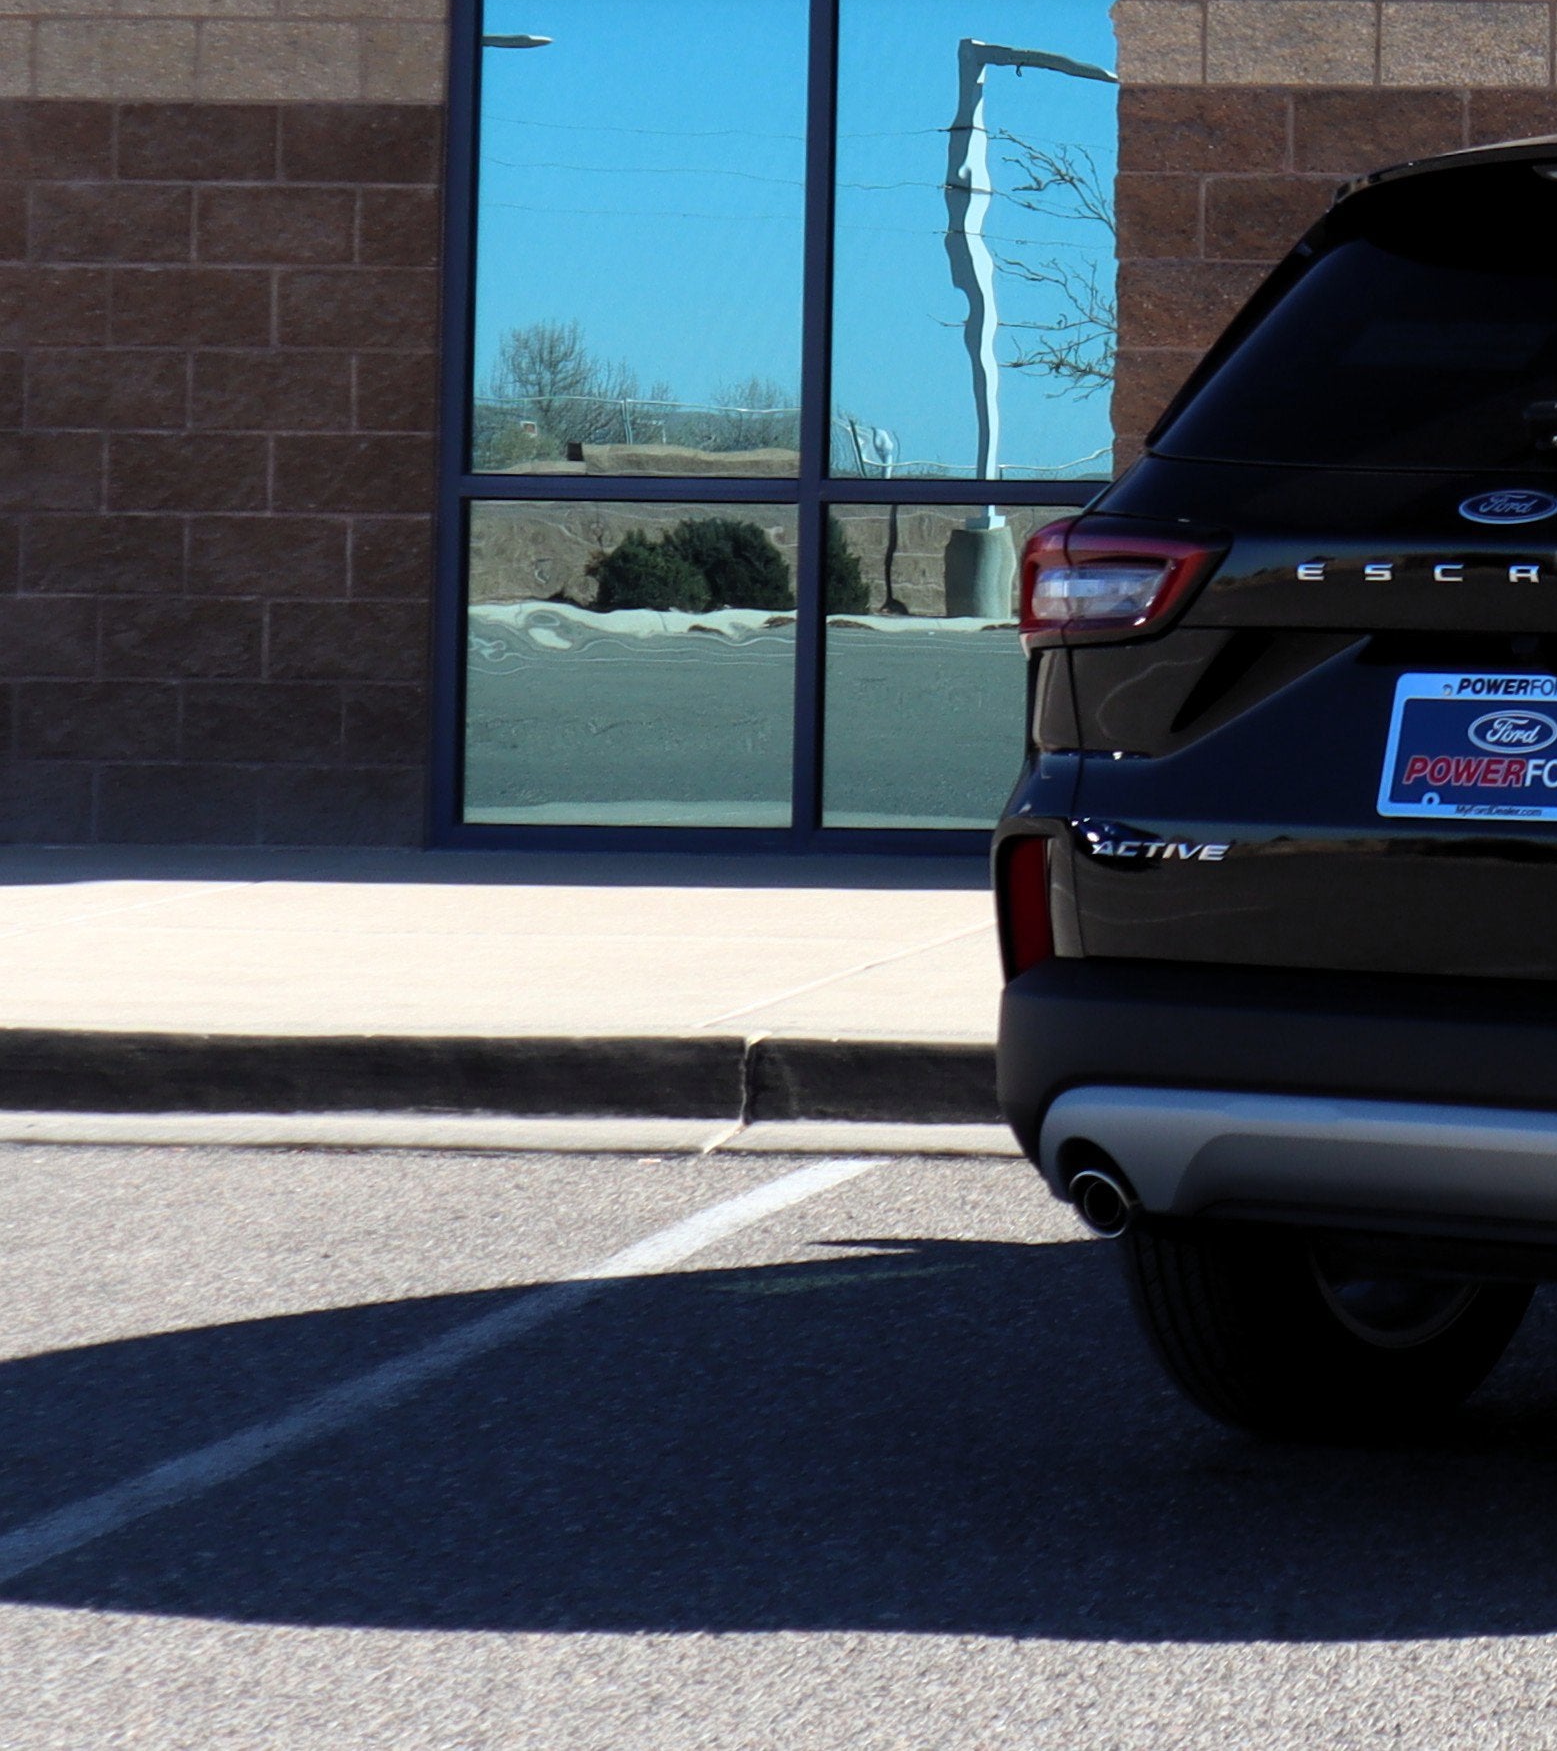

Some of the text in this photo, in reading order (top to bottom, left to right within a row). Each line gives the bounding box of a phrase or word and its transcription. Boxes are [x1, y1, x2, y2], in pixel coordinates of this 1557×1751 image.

[1478, 493, 1538, 514] Ford
[1486, 716, 1541, 744] Ford
[1091, 840, 1231, 862] ACTIVE
